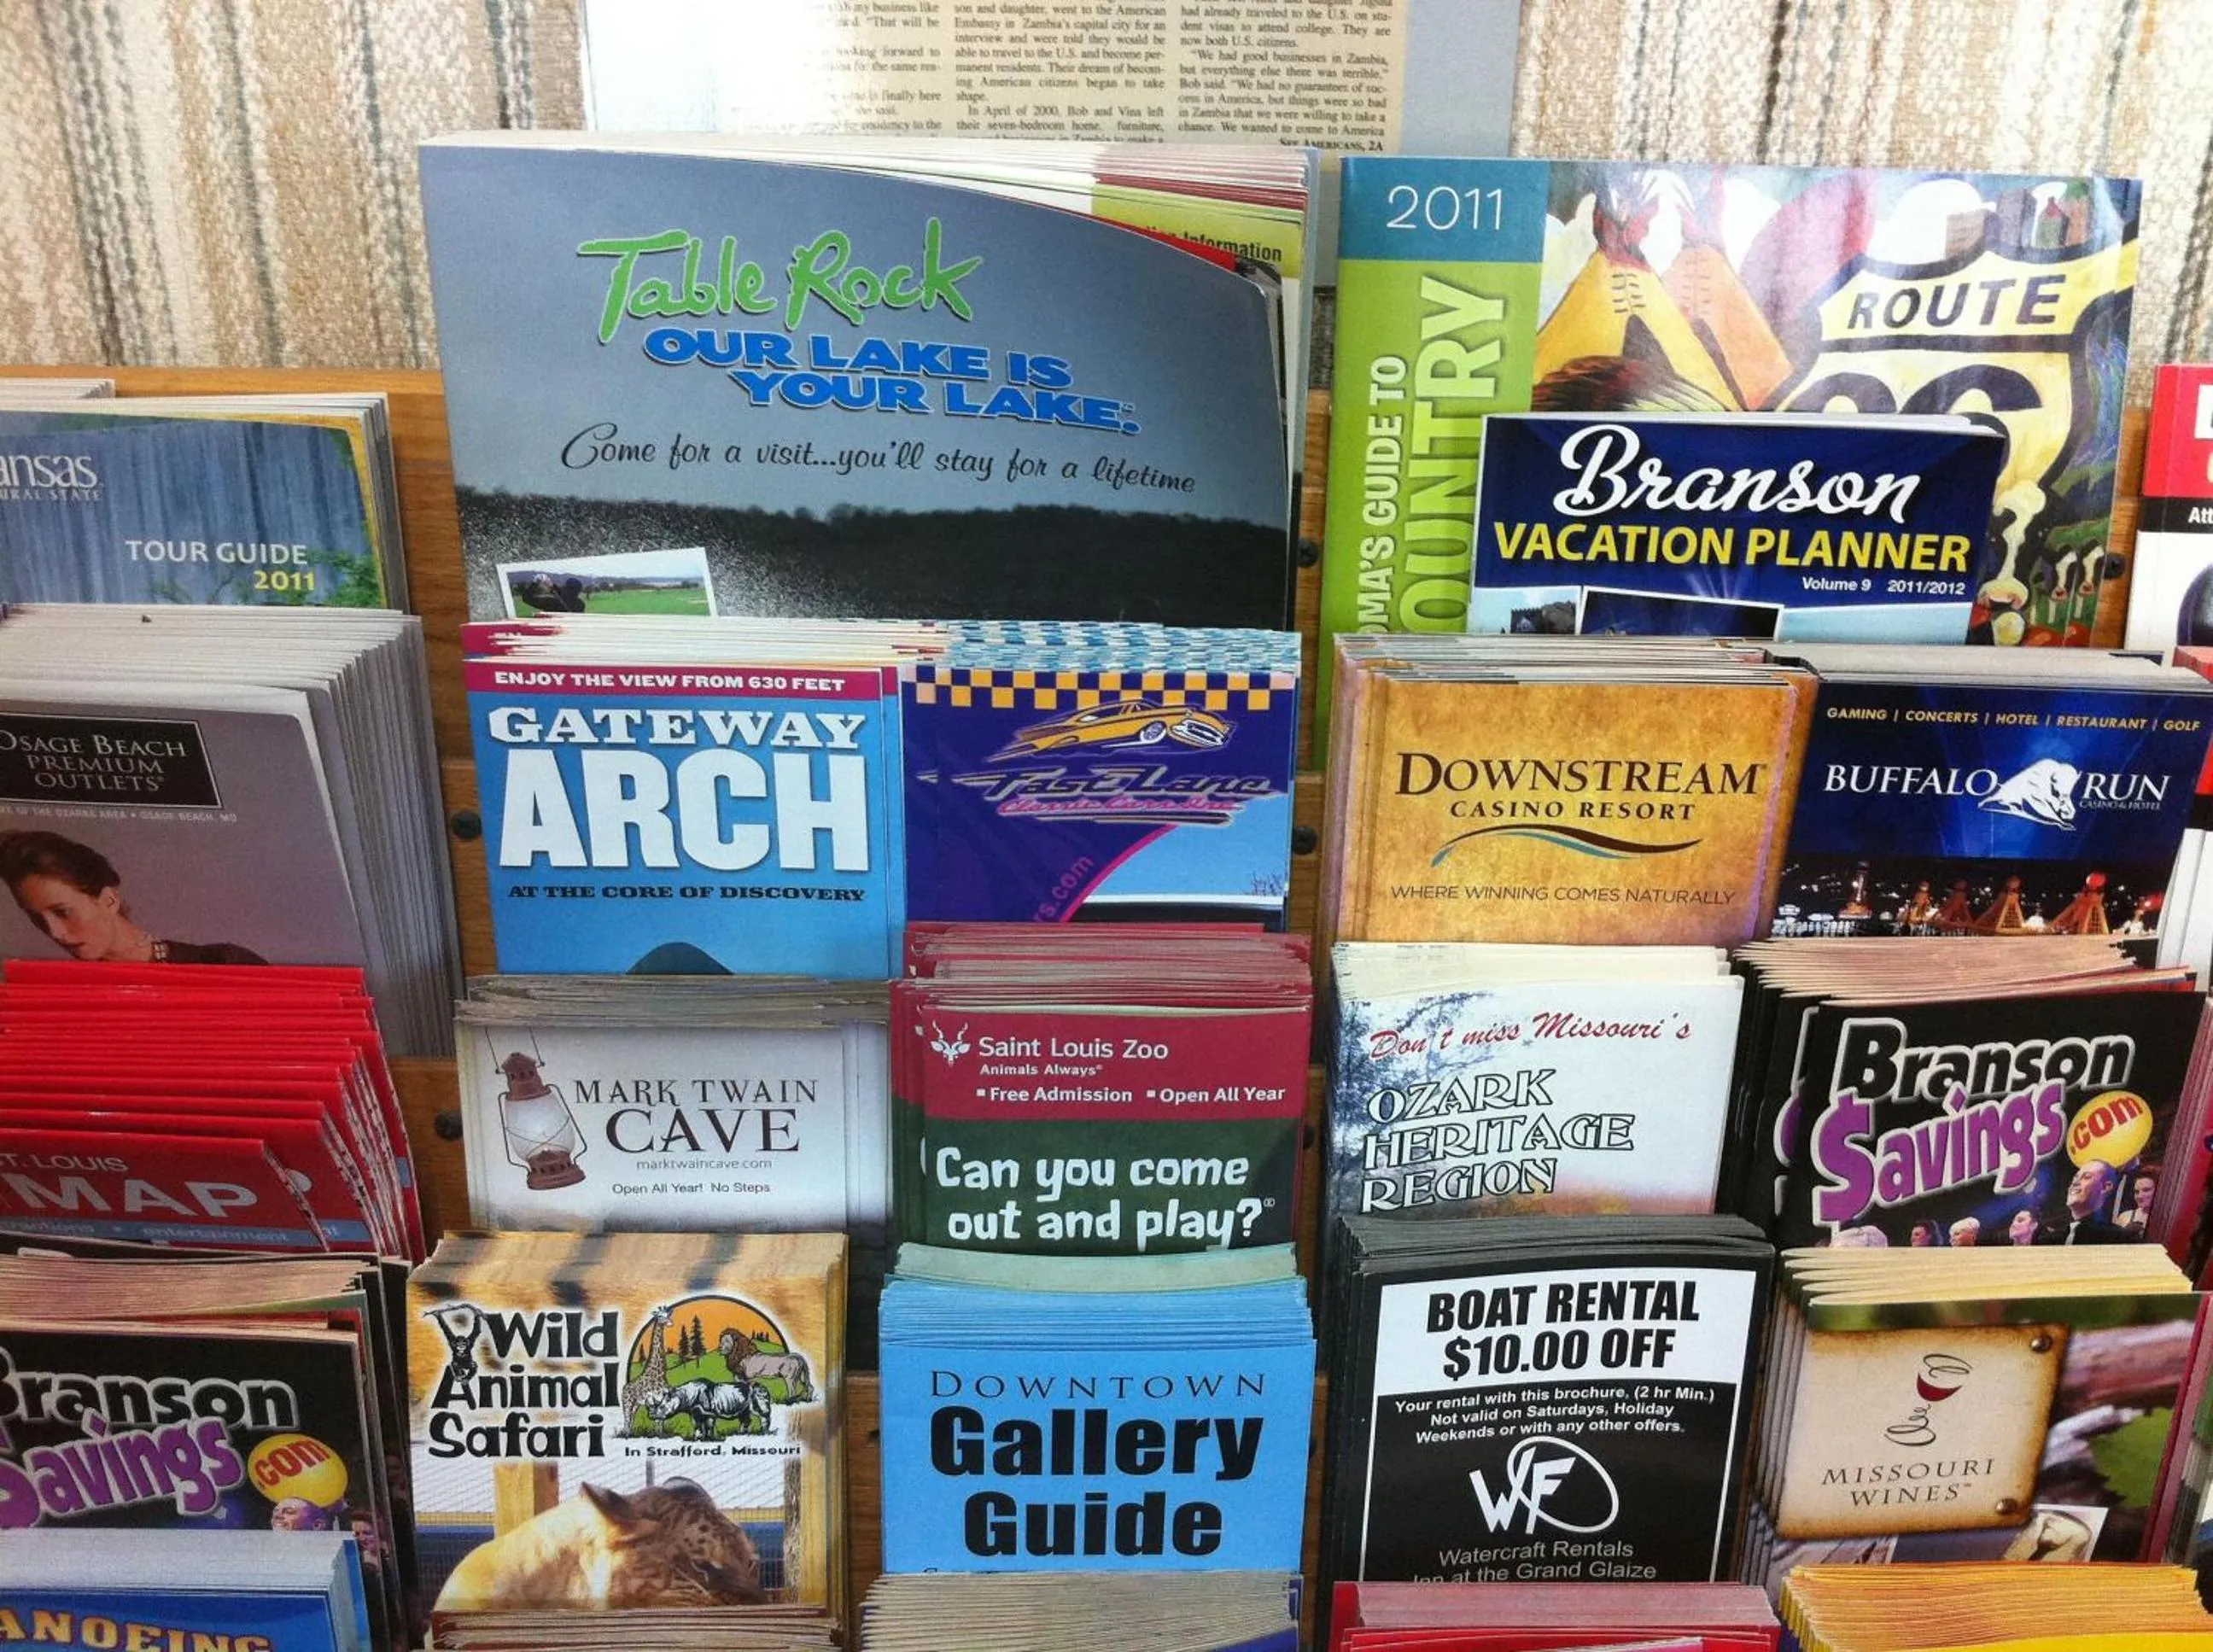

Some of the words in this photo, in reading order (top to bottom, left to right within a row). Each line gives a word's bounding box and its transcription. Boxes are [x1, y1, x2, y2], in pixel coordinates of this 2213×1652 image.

[1342, 24, 1366, 37] They
[1375, 27, 1390, 36] are
[1201, 66, 1255, 78] everything
[1260, 67, 1280, 77] else
[1287, 67, 1311, 77] there
[1218, 51, 1236, 61] had
[1243, 51, 1268, 63] good
[1273, 52, 1326, 62] businesses
[1332, 53, 1341, 63] in
[1386, 185, 1504, 231] 2011
[577, 228, 778, 345] Table
[786, 217, 983, 331] Rock
[1847, 274, 2066, 330] ROUTE
[645, 327, 801, 368] OUR
[810, 334, 991, 381] LAKE
[1007, 351, 1074, 389] IS
[728, 371, 933, 415] YOUR
[1369, 355, 1407, 406] TO
[0, 454, 97, 487] ansas
[561, 422, 657, 470] Come
[669, 432, 711, 470] for
[724, 444, 742, 464] a
[936, 446, 994, 480] stay
[1007, 448, 1047, 482] for
[1061, 461, 1077, 478] a
[1094, 455, 1195, 493] lifetime
[1363, 415, 1404, 527] GUIDE
[1399, 276, 1504, 633] OUNTRY
[1553, 424, 1921, 524] Branson
[126, 540, 208, 563] TOUR
[216, 542, 308, 566] GUIDE
[1495, 522, 1733, 566] VACATION
[1745, 527, 1971, 572] PLANNER
[254, 571, 316, 592] 2011
[1801, 576, 1853, 593] Volume
[1860, 578, 1871, 593] 9
[1887, 581, 1965, 596] 2011/2012
[495, 671, 563, 686] ENJOY
[571, 673, 613, 687] THE
[619, 674, 676, 688] VIEW
[682, 675, 744, 689] FROM
[749, 676, 785, 690] 630
[792, 678, 845, 692] FEET
[488, 706, 866, 748] GATEWAY
[1827, 708, 1887, 721] GAMING
[1905, 710, 1978, 724] CONCERTS
[1995, 714, 2038, 727] HOTEL
[2057, 715, 2148, 730] RESTAURANT
[2163, 719, 2201, 732] GOLF
[26, 755, 165, 774] PREMIUM
[92, 734, 188, 758] BEACH
[1395, 752, 1759, 795] DOWNSTREAM
[1824, 764, 1998, 797] BUFFALO
[2083, 772, 2172, 801] RUN
[499, 748, 869, 872] ARCH
[1451, 801, 1563, 819] CASINO
[1579, 803, 1695, 820] RESORT
[509, 886, 538, 898] AT
[544, 886, 594, 899] THE
[602, 886, 673, 899] CORE
[680, 886, 715, 899] OF
[720, 886, 866, 902] DISCOVERY
[1391, 884, 1458, 899] WHERE
[1465, 886, 1549, 901] WINNING
[1554, 887, 1620, 902] COMES
[1626, 889, 1736, 905] NATURALLY
[978, 1036, 1041, 1058] Saint
[1051, 1038, 1113, 1059] Louis
[1123, 1039, 1169, 1059] Zoo
[1370, 1027, 1454, 1059] Don't
[1462, 1022, 1521, 1047] miss
[1532, 1013, 1691, 1040] Missouri's
[980, 1065, 1038, 1076] Animals
[1829, 1017, 2135, 1104] Branson
[573, 1079, 680, 1107] MARK
[692, 1079, 818, 1103] TWAIN
[990, 1088, 1029, 1101] Free
[1033, 1087, 1133, 1102] Admission
[1160, 1088, 1209, 1104] Open
[1214, 1087, 1240, 1100] All
[1242, 1087, 1286, 1100] Year
[1367, 1068, 1556, 1124] OZARK
[605, 1108, 800, 1153] CAVE
[1363, 1112, 1636, 1170] HERITAGE
[33, 1154, 129, 1172] LOUIS
[636, 1158, 773, 1170] marktwaincave.com
[937, 1147, 1019, 1190] Can
[1036, 1159, 1115, 1203] you
[1130, 1156, 1249, 1186] come
[2, 1172, 258, 1217] MAP
[611, 1183, 648, 1196] Open
[651, 1182, 668, 1194] All
[670, 1182, 704, 1194] Year!
[711, 1183, 730, 1194] No
[734, 1182, 770, 1196] Steps
[1360, 1158, 1557, 1214] REGION
[949, 1200, 1022, 1240] out
[1036, 1199, 1121, 1240] and
[1137, 1197, 1263, 1252] play?
[1427, 1285, 1537, 1334] BOAT
[1544, 1280, 1700, 1324] RENTAL
[482, 1311, 619, 1358] Wild
[1443, 1329, 1590, 1381] $10.00
[1599, 1328, 1676, 1368] OFF
[431, 1363, 620, 1410] Animal
[931, 1370, 1265, 1400] DOWNTOWN
[1395, 1398, 1433, 1414] Your
[1436, 1393, 1480, 1410] rental
[1484, 1391, 1516, 1406] with
[1521, 1388, 1550, 1403] this
[1554, 1386, 1631, 1403] brochure,
[1634, 1386, 1650, 1401] (2
[1654, 1386, 1671, 1399] hr
[1675, 1386, 1715, 1403] Min.)
[428, 1413, 606, 1459] Safari
[1416, 1427, 1496, 1445] Weekends
[1499, 1426, 1518, 1437] or
[1521, 1420, 1553, 1435] with
[1556, 1421, 1585, 1435] any
[1588, 1417, 1632, 1432] other
[1634, 1416, 1685, 1433] offers.
[1430, 1413, 1458, 1427] Not
[1461, 1409, 1498, 1425] valid
[1502, 1410, 1522, 1421] on
[1526, 1404, 1610, 1420] Saturdays,
[1614, 1403, 1675, 1419] Holiday
[624, 1446, 640, 1456] In
[732, 1445, 801, 1456] Missouri
[930, 1405, 1264, 1481] Gallery
[1821, 1458, 1995, 1486] MISSOURI
[964, 1491, 1223, 1557] Guide
[1439, 1541, 1545, 1567] Watercraft
[1551, 1540, 1633, 1558] Rentals
[1476, 1567, 1509, 1581] the
[1515, 1562, 1581, 1579] Grand
[1587, 1561, 1656, 1579] Glaize
[0, 1607, 272, 1652] ANOEING
